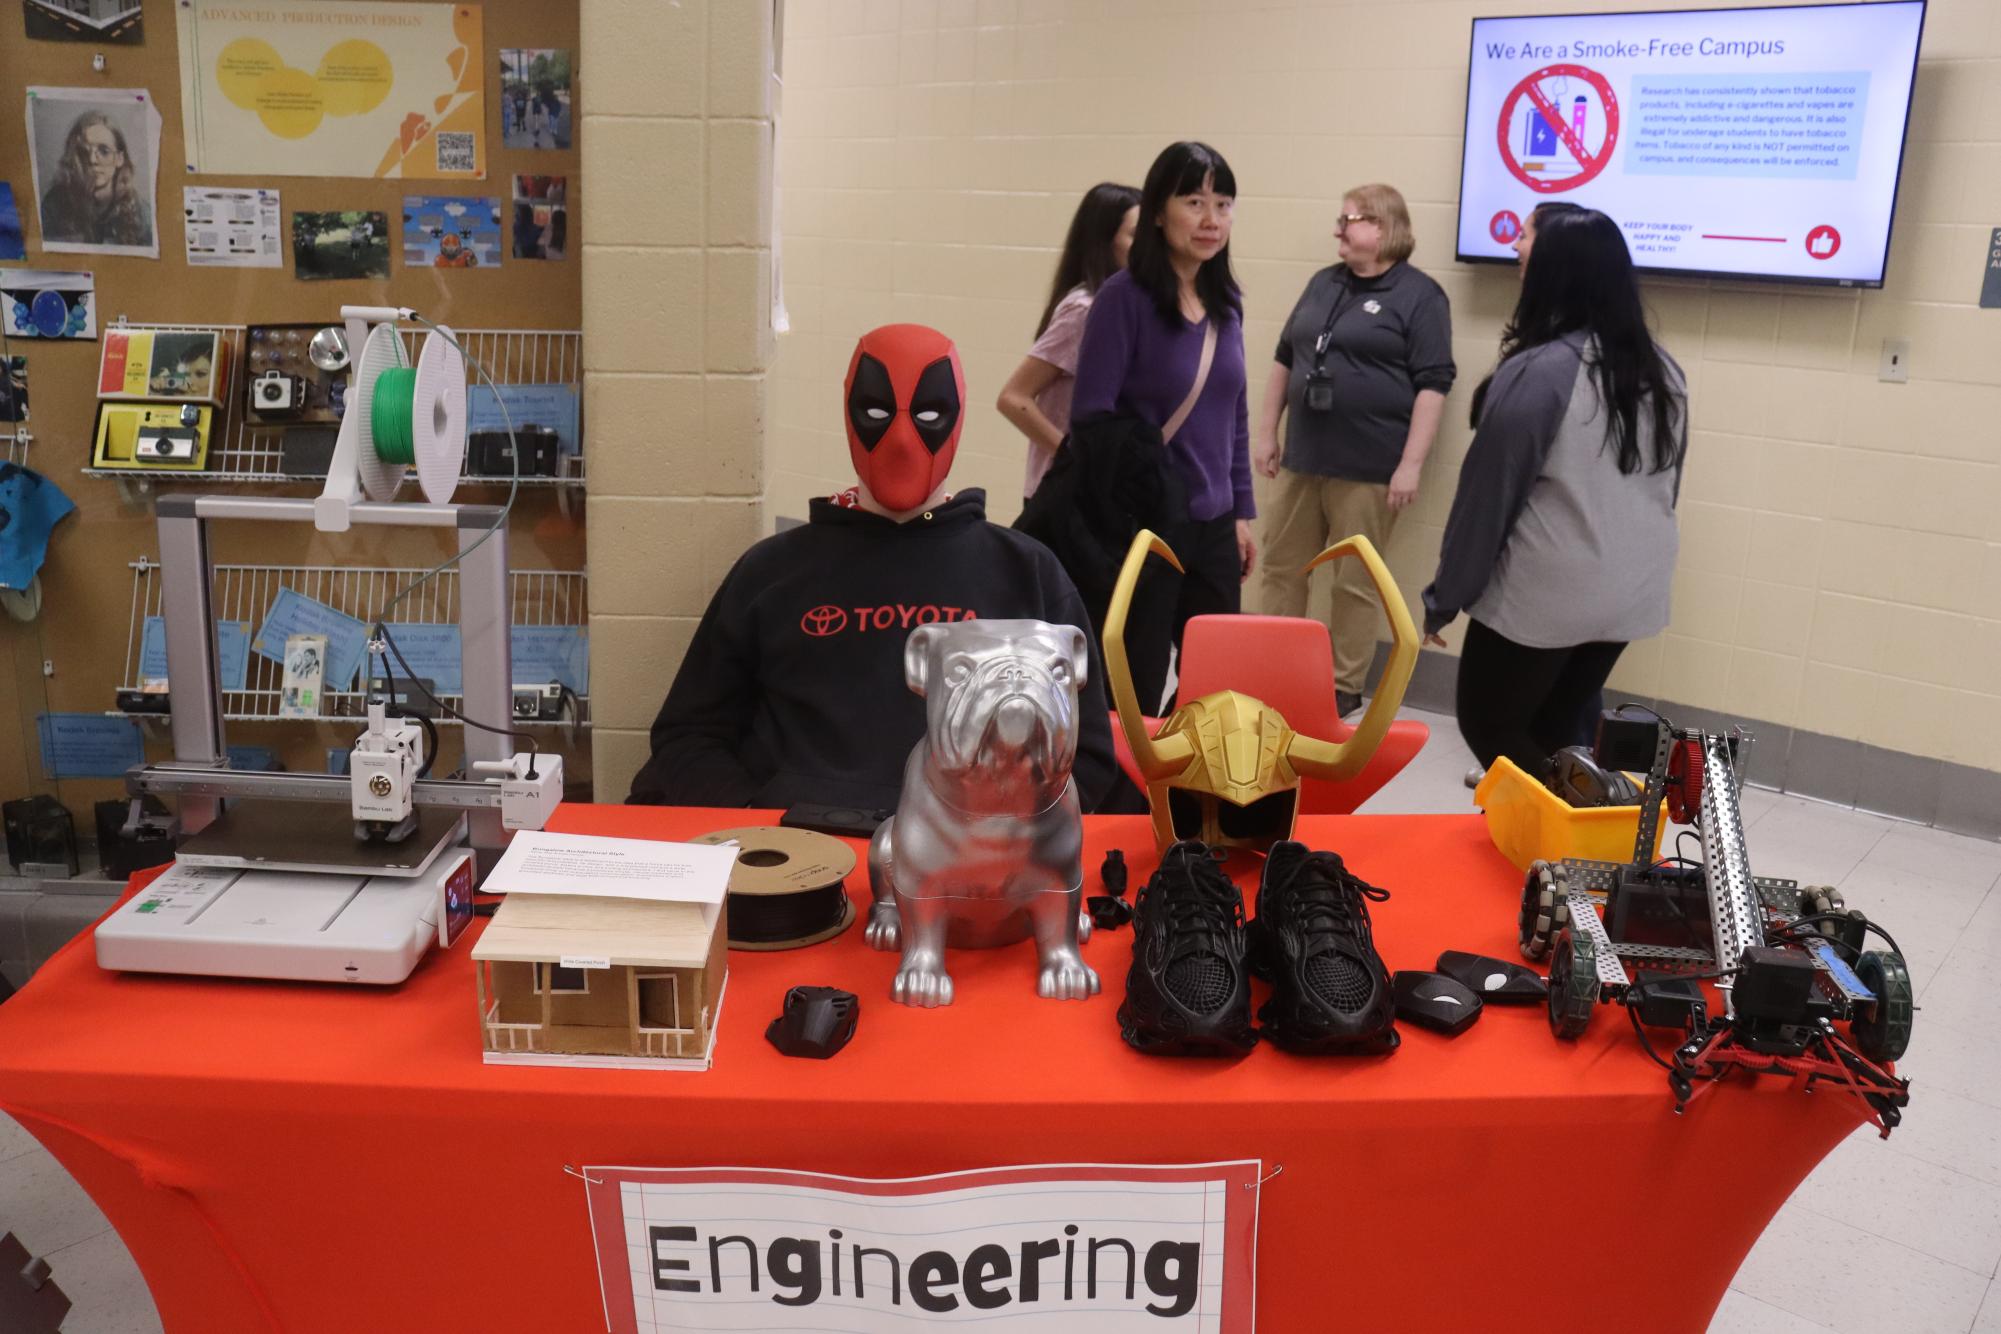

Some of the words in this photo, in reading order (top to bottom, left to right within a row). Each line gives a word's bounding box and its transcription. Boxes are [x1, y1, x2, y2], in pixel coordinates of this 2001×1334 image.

[201, 8, 276, 23] ADVANCED
[282, 11, 368, 26] PRODUCTION
[371, 14, 423, 27] DESIGN
[1486, 42, 1516, 59] We
[1519, 41, 1553, 59] Are
[1557, 45, 1568, 59] a
[1573, 38, 1694, 59] Smoke-Free
[1699, 37, 1785, 58] Campus
[1641, 86, 1682, 95] Research
[1684, 87, 1700, 95] has
[1702, 87, 1758, 96] consistently
[1760, 87, 1792, 95] shown
[1793, 86, 1814, 95] that
[1815, 86, 1856, 95] tobacco
[1684, 101, 1725, 110] including
[1727, 101, 1785, 110] e-cigarettes
[1786, 101, 1805, 109] and
[1806, 102, 1835, 110] vapes
[1643, 114, 1687, 124] extremely
[1689, 114, 1731, 123] addictive
[1732, 115, 1750, 123] and
[1815, 115, 1824, 123] is
[1826, 114, 1847, 123] also
[1667, 128, 1680, 136] for
[1682, 128, 1724, 138] underage
[1727, 128, 1767, 137] students
[1769, 128, 1779, 137] to
[1781, 129, 1805, 137] have
[1806, 129, 1847, 138] tobacco
[1664, 140, 1701, 149] Tobacco
[1702, 141, 1713, 149] of
[1714, 143, 1729, 152] any
[1732, 142, 1752, 150] kind
[1753, 143, 1761, 151] is
[1763, 142, 1785, 151] NOT
[1786, 142, 1836, 152] permitted
[1837, 143, 1850, 151] on
[1696, 156, 1761, 165] consequences
[1763, 156, 1779, 165] will
[1780, 156, 1792, 165] be
[1623, 222, 1645, 230] KEEP
[1646, 223, 1669, 231] YOUR
[1670, 224, 1694, 232] BODY
[1633, 234, 1662, 242] HAPPY
[1663, 234, 1681, 242] AND
[526, 791, 540, 799] A1
[648, 1223, 1201, 1318] Engineering
